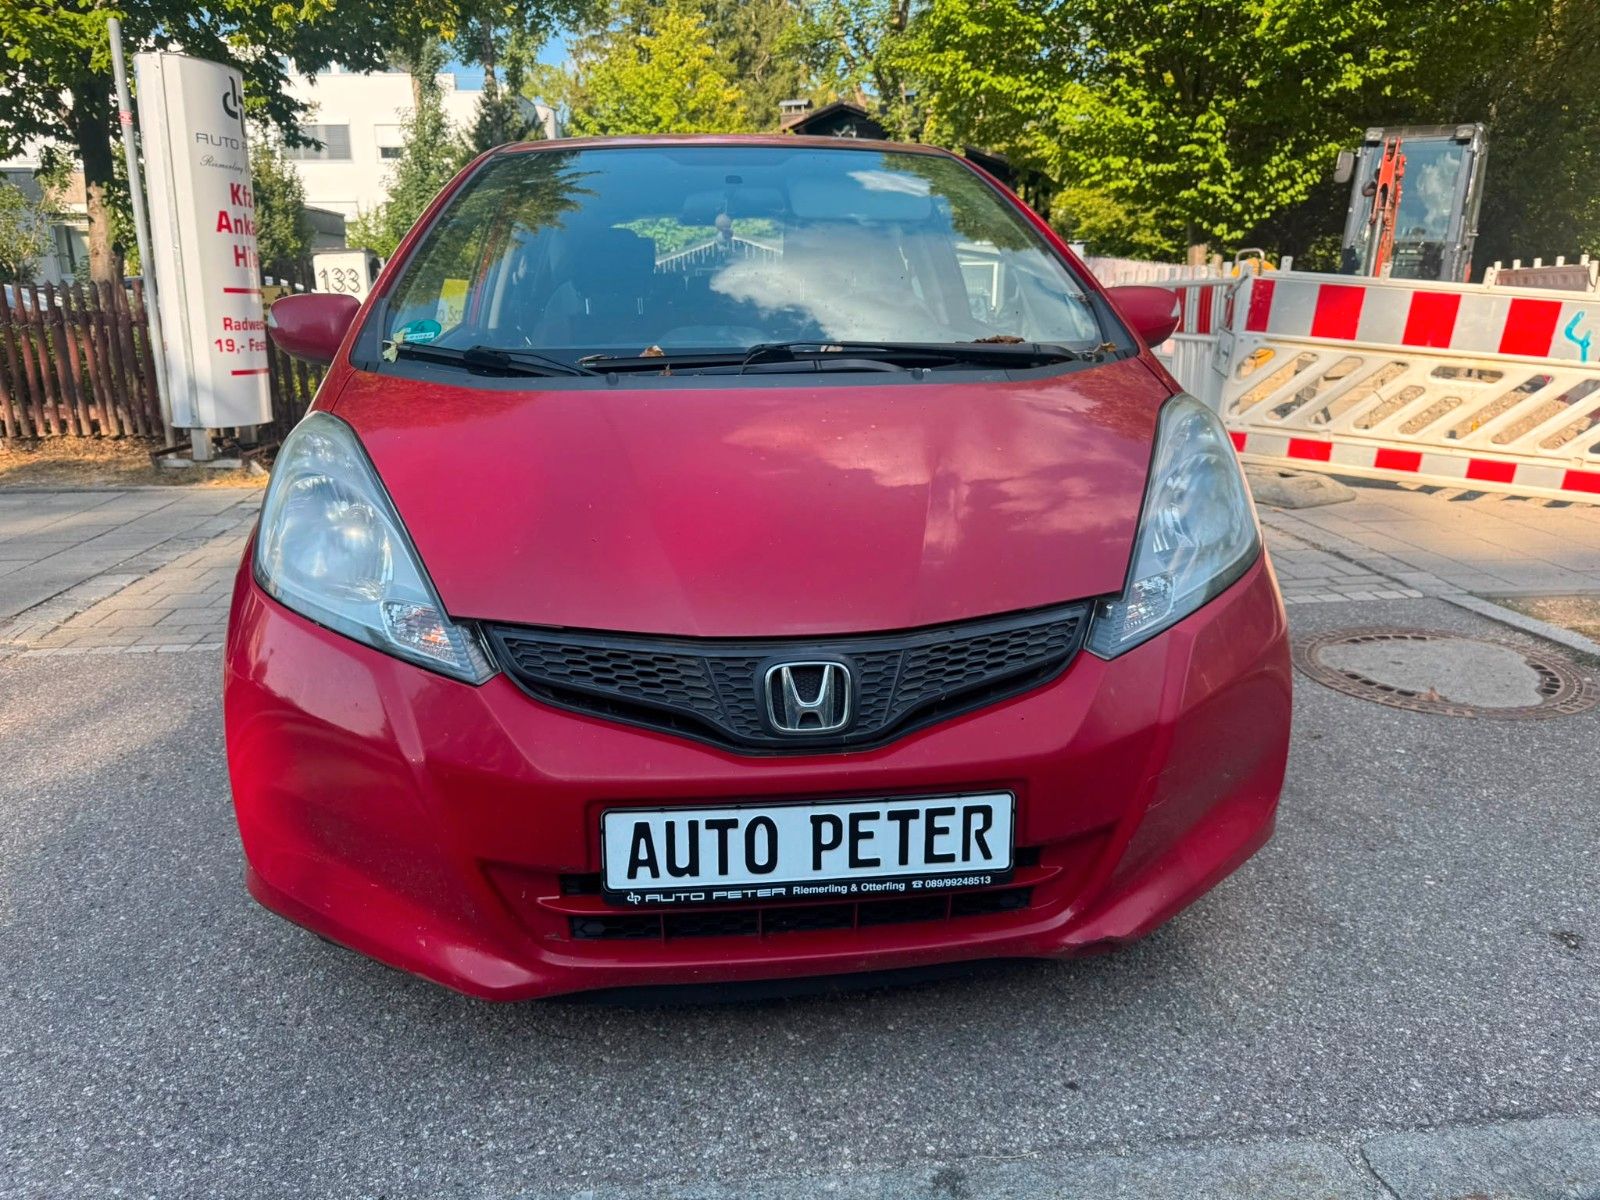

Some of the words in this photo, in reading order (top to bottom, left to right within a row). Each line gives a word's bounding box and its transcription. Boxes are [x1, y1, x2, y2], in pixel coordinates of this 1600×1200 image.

[195, 132, 240, 151] AUTO
[318, 266, 361, 293] 133
[1564, 310, 1592, 363] 4
[626, 815, 779, 879] AUTO
[809, 804, 993, 871] PETER
[645, 892, 705, 902] AUTO
[713, 887, 786, 900] PETER
[792, 884, 848, 895] Riemerling
[850, 883, 858, 892] &
[861, 882, 905, 893] Otterfing
[925, 875, 991, 888] 089/99248513
